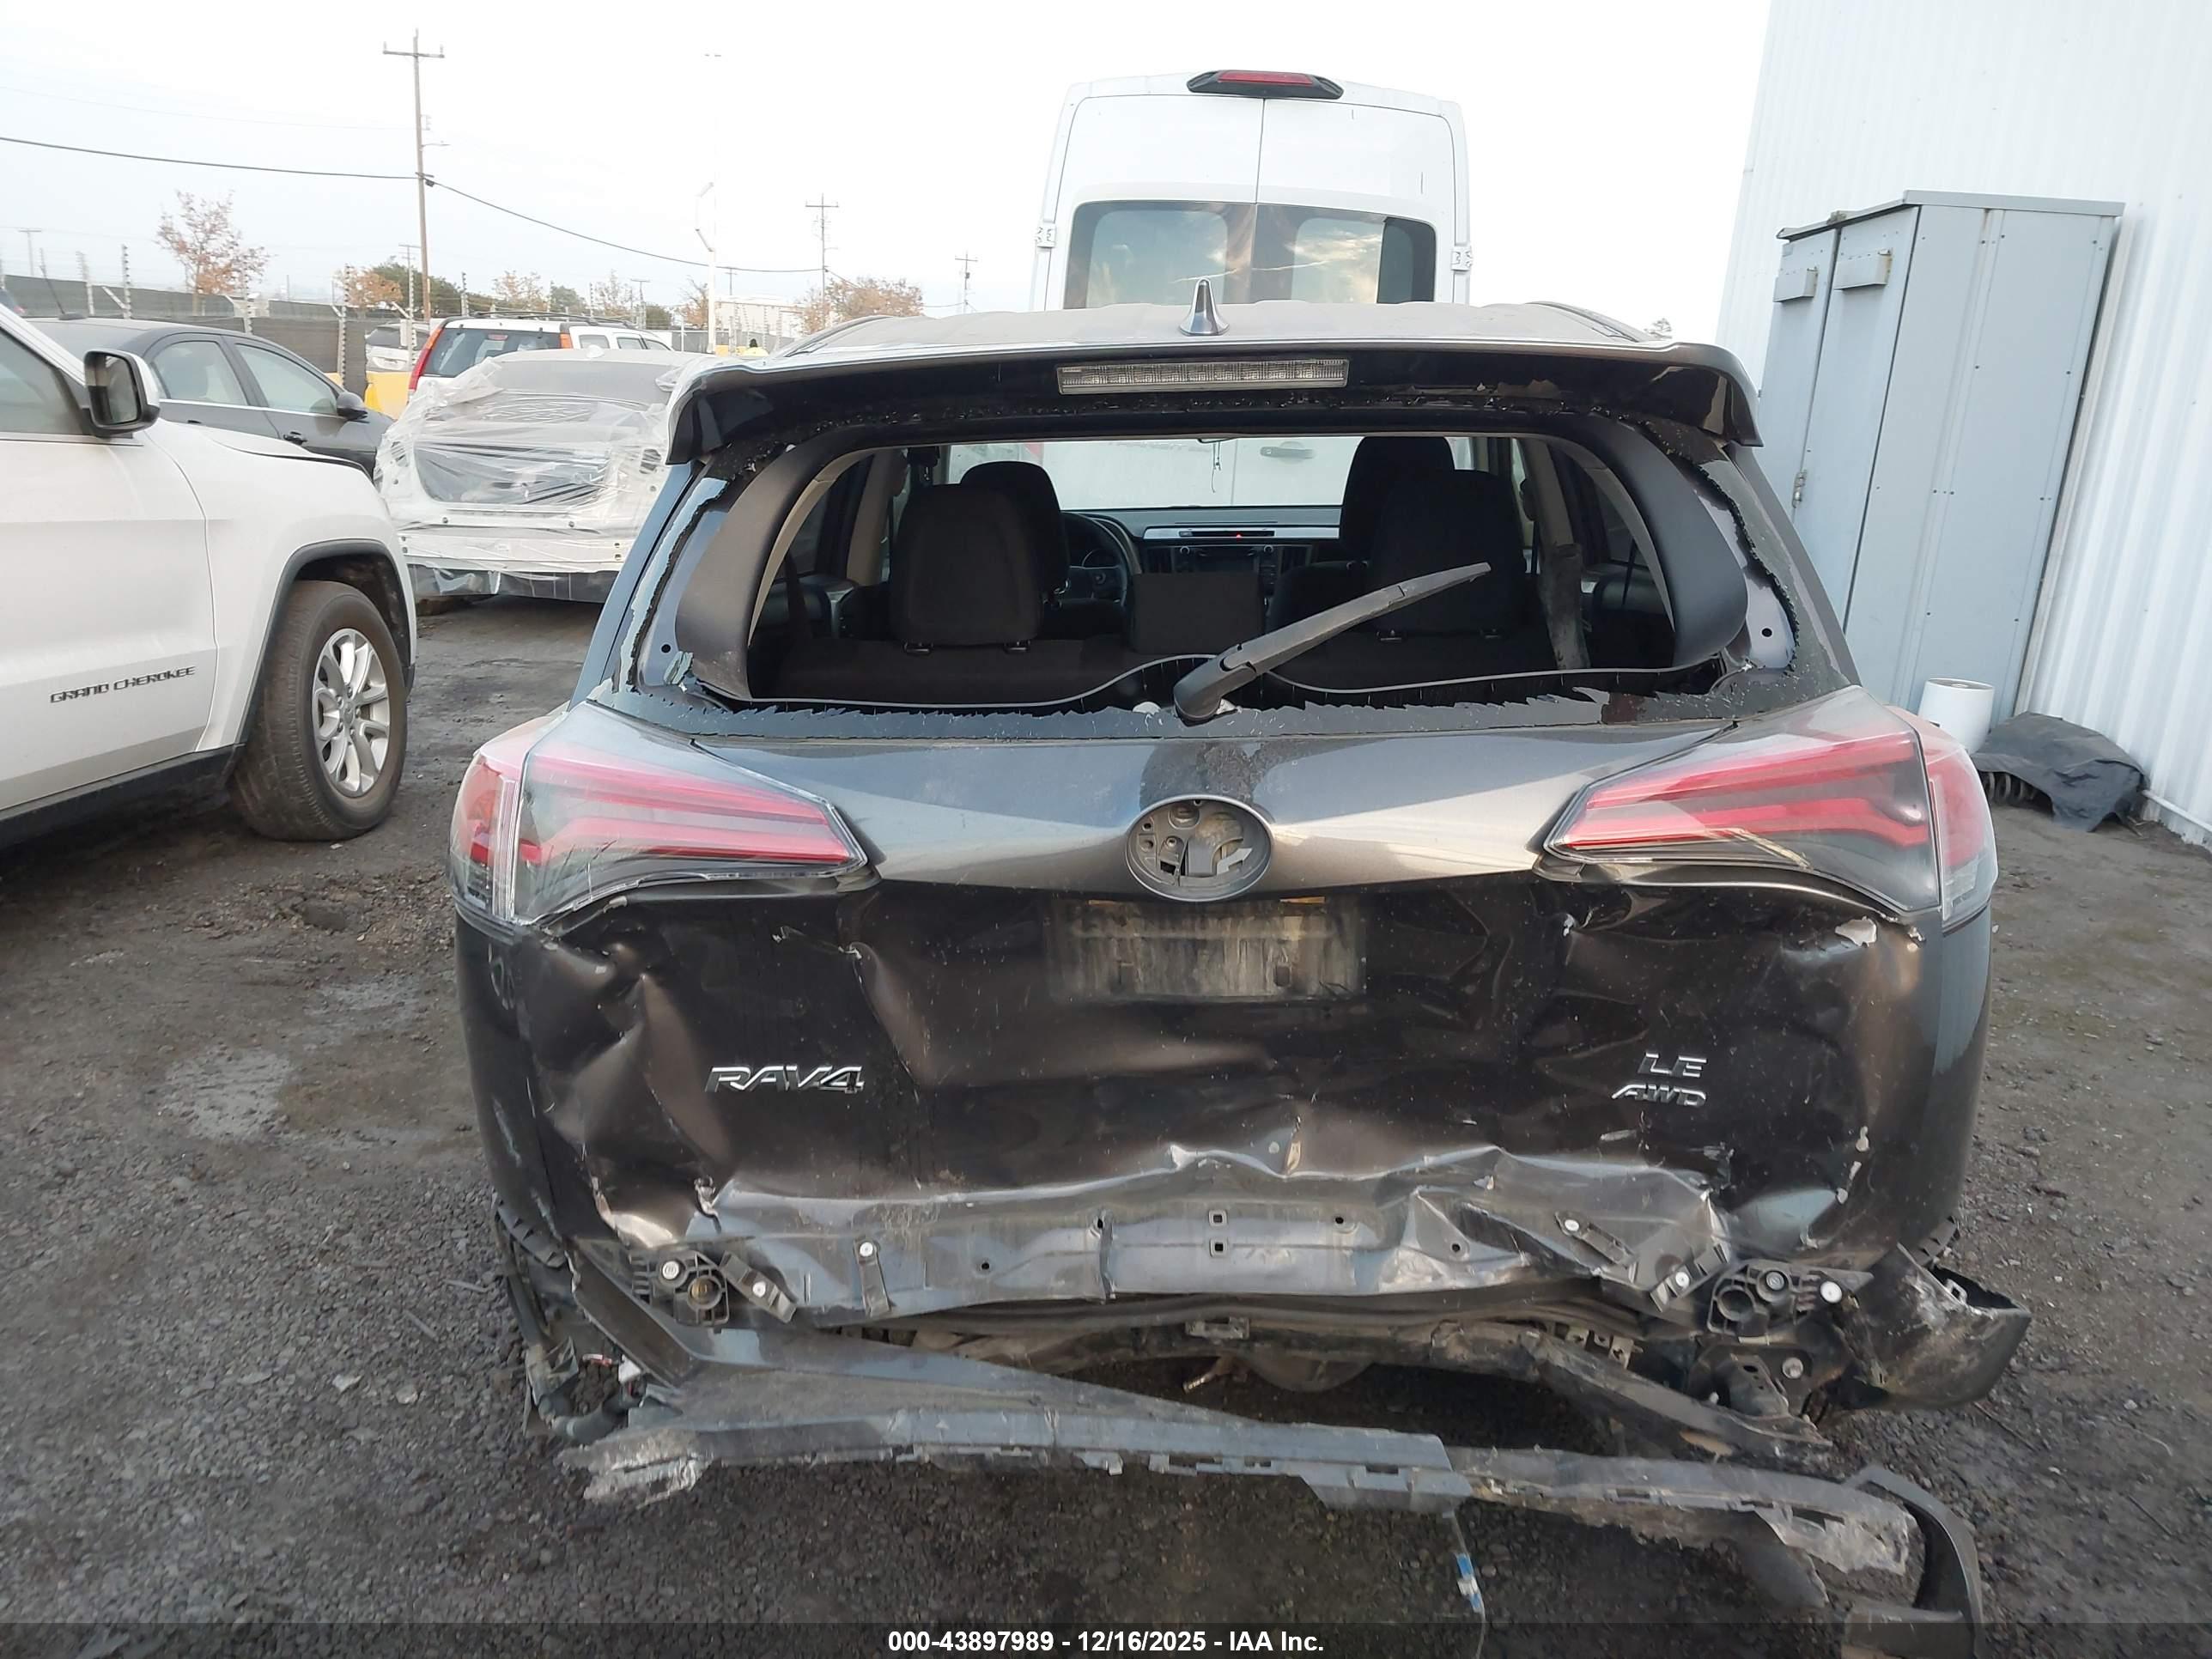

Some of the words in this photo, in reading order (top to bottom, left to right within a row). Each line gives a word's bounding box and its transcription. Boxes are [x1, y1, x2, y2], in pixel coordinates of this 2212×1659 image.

[50, 683, 109, 703] GRAND
[113, 665, 196, 690] CHEROKEE
[704, 1065, 865, 1094] RAV4
[1638, 1052, 1707, 1079] LE
[1611, 1084, 1707, 1107] AWD
